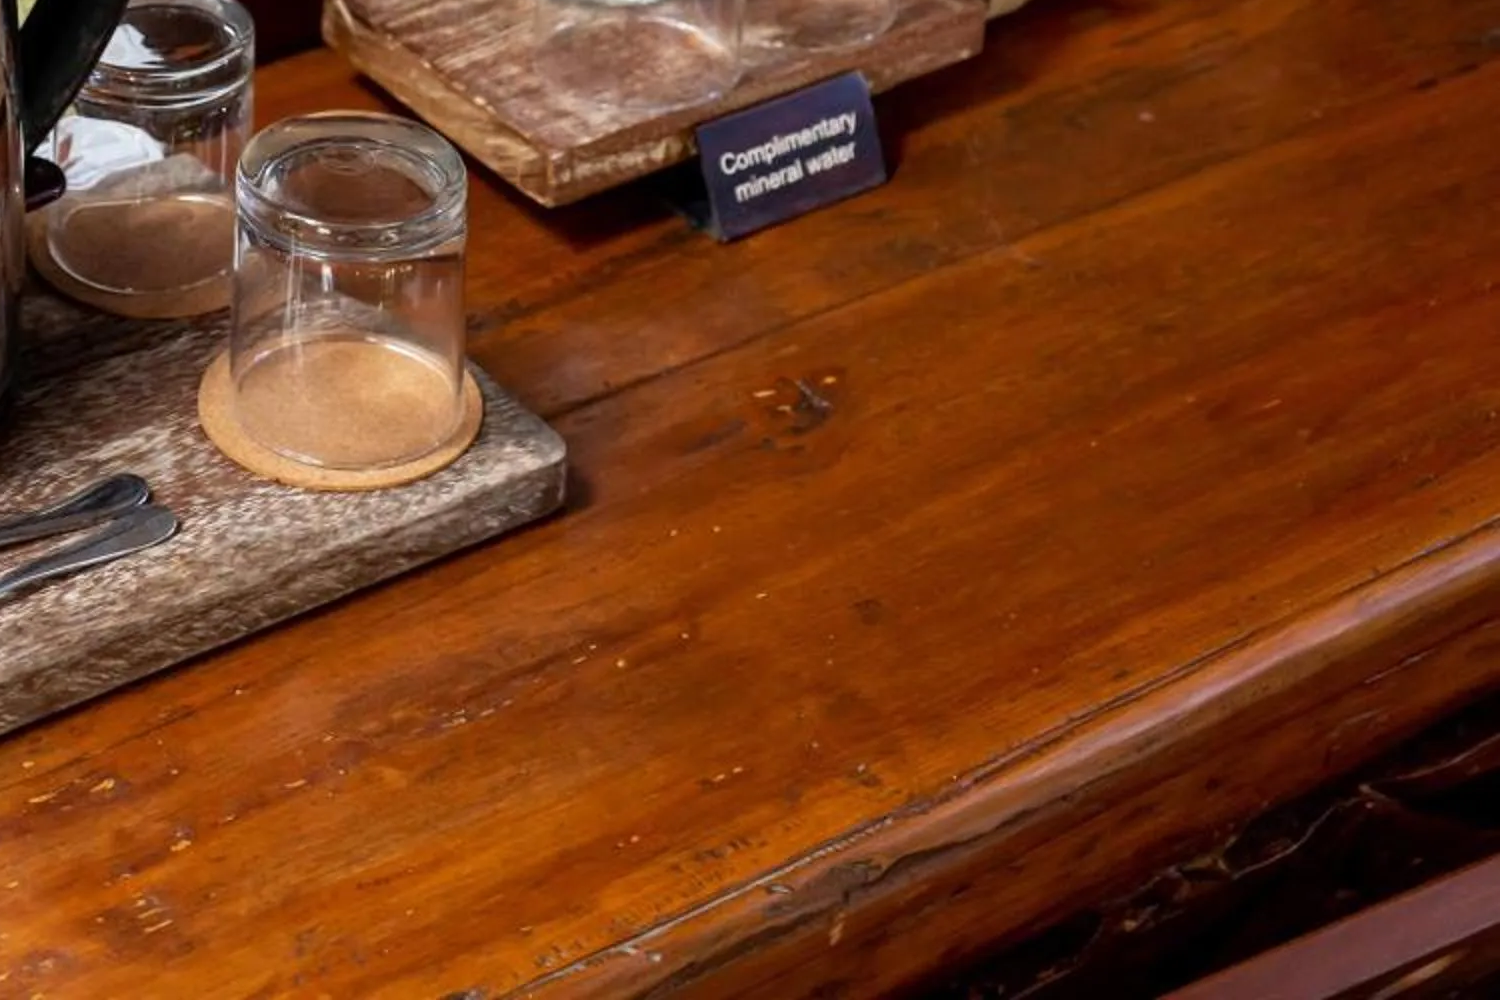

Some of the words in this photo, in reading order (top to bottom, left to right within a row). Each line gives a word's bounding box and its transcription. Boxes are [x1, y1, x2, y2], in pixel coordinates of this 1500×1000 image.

[720, 111, 857, 175] Complimentary
[734, 160, 803, 203] mineral
[805, 142, 857, 176] water
